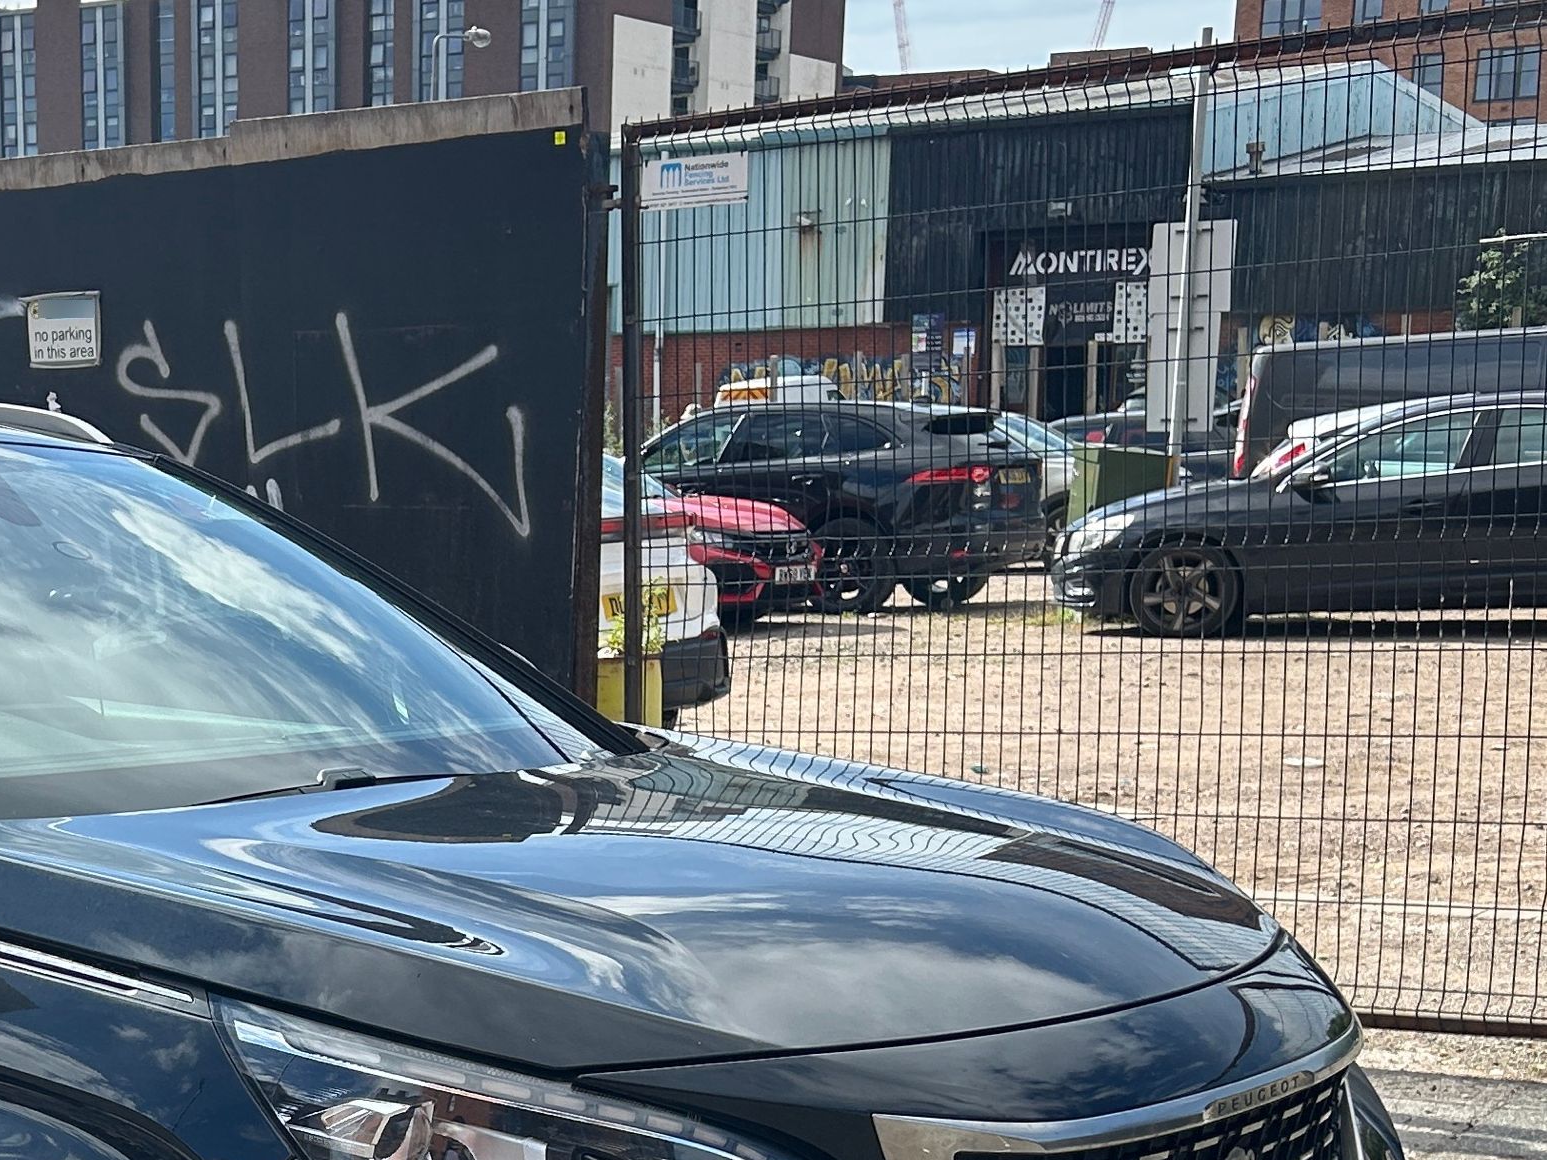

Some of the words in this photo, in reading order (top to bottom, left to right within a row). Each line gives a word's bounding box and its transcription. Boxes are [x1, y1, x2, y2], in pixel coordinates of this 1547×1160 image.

[684, 160, 730, 171] Nationwide
[1009, 247, 1154, 276] MONTIREX
[34, 331, 49, 342] no
[51, 326, 92, 344] parking
[34, 346, 44, 359] in
[47, 345, 66, 359] this
[70, 346, 94, 359] area
[1217, 1075, 1302, 1115] PEUGEOT
